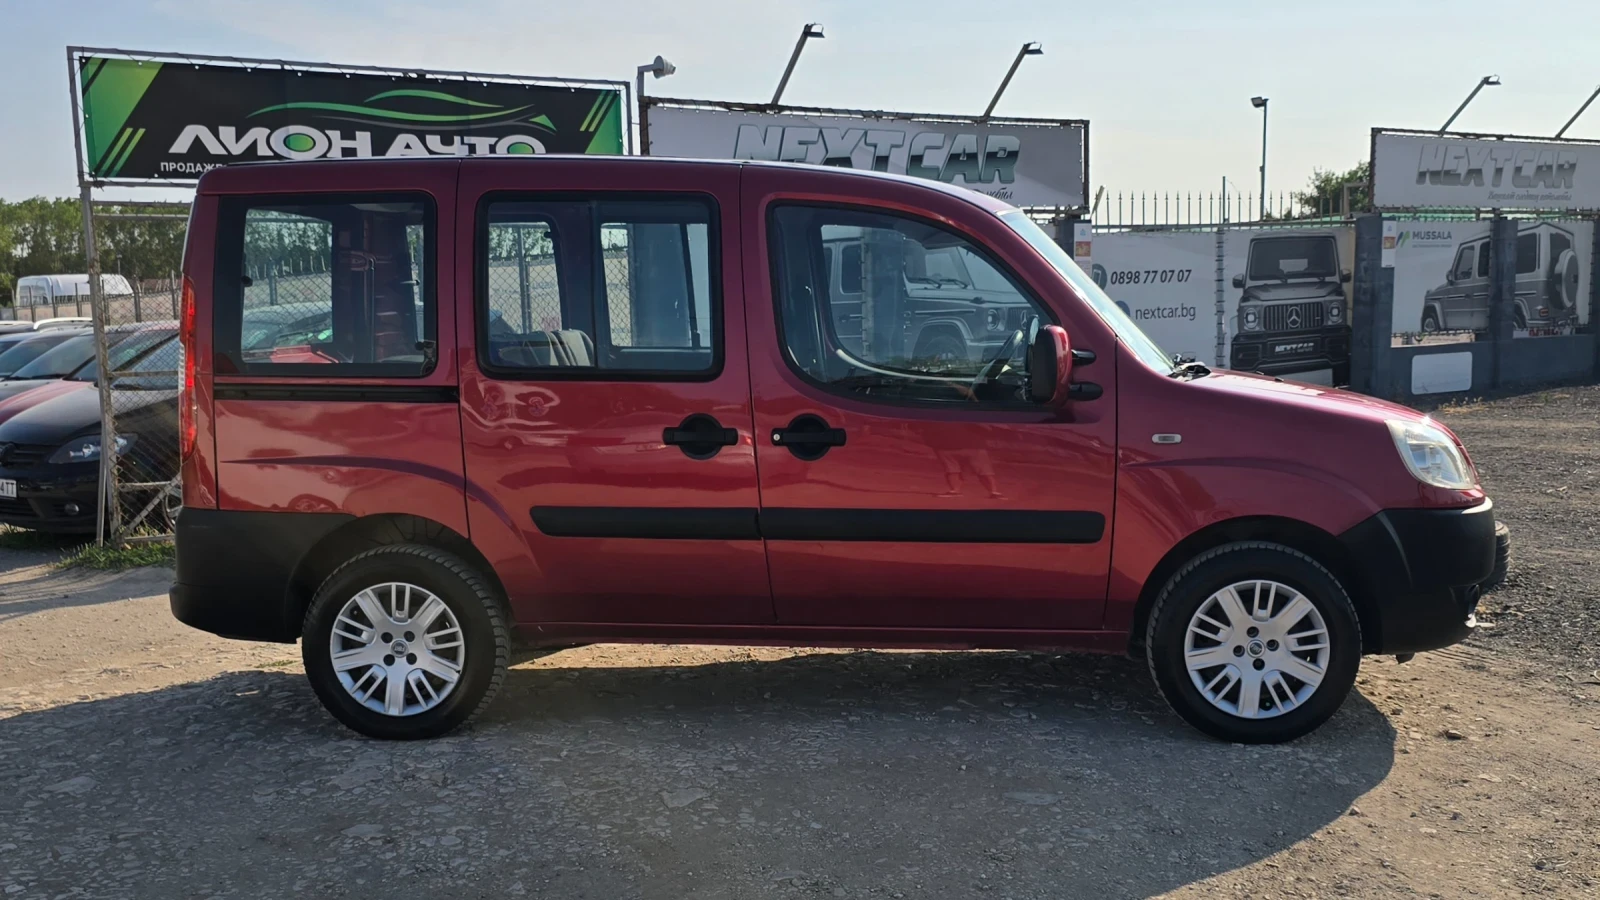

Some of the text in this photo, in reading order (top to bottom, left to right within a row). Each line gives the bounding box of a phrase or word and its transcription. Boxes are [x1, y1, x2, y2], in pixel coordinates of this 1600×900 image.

[733, 124, 1020, 184] NEXTCAR
[1416, 143, 1579, 189] NEXTCAR
[1412, 231, 1452, 240] MUSSALA
[1110, 269, 1192, 285] 0898 77 07 07
[1135, 303, 1197, 321] nextcar.bg
